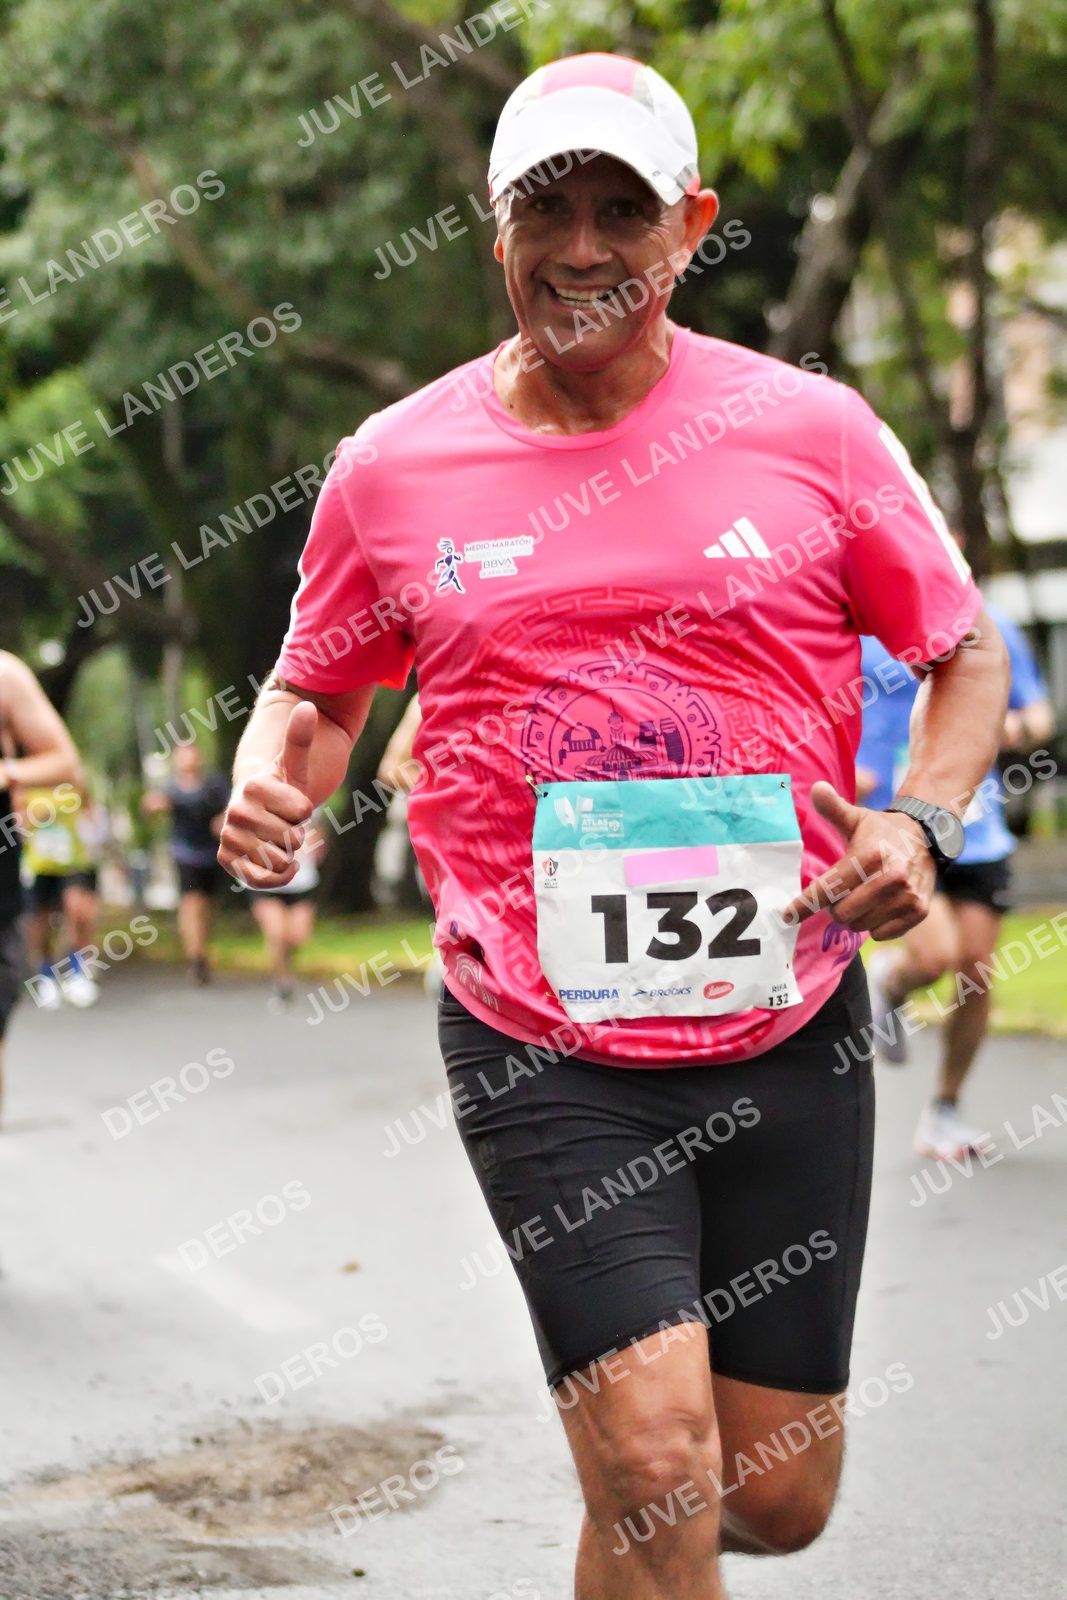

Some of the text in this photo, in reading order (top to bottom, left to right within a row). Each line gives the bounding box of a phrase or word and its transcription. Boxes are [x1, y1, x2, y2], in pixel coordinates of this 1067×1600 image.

[465, 538, 531, 552] MEDIO MARATÓN
[484, 558, 512, 569] BBVA
[591, 888, 760, 963] 132
[558, 988, 620, 1000] PERDURA
[650, 986, 692, 997] BROOKS
[771, 983, 788, 993] RIFA
[768, 993, 789, 1007] 132
